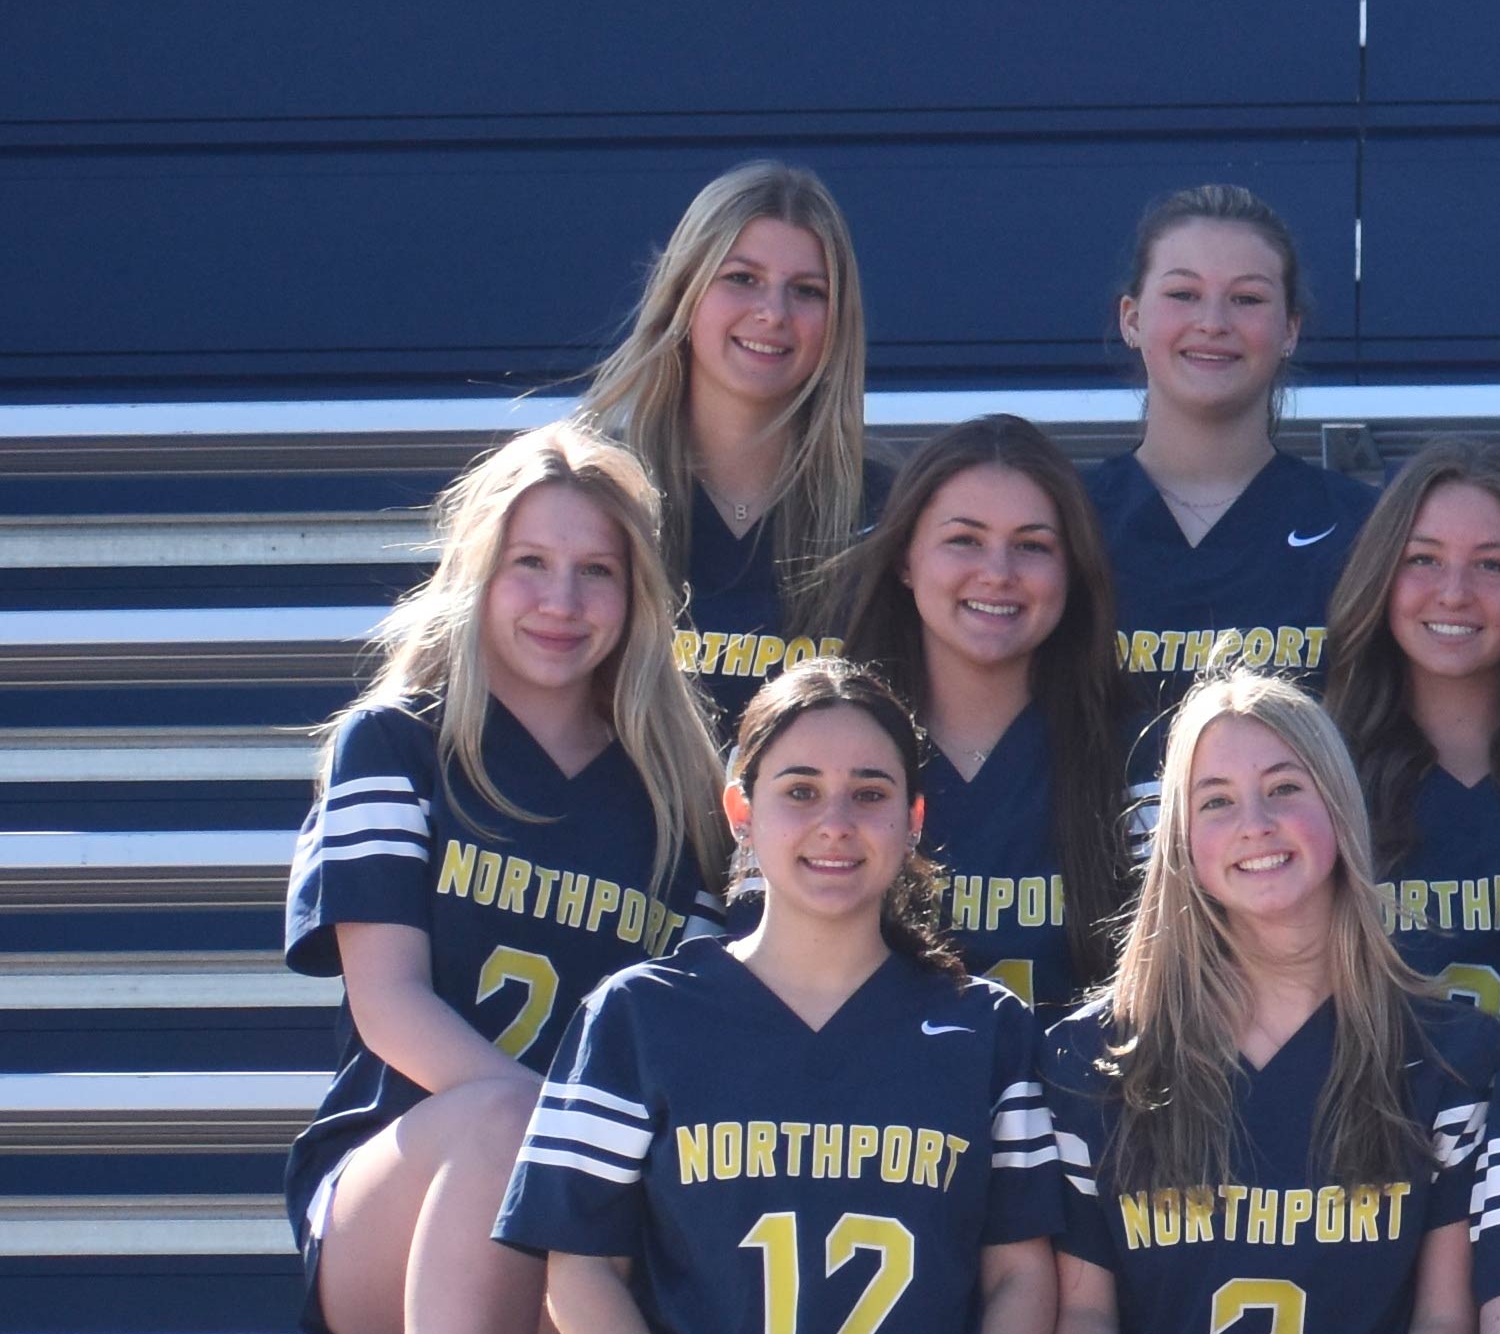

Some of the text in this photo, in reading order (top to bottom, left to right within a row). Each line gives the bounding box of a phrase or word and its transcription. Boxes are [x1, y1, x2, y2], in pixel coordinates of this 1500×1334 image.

[436, 839, 686, 959] NORTHPORT
[676, 1120, 970, 1193] NORTHPORT
[1119, 1181, 1411, 1250] NORTHPORT
